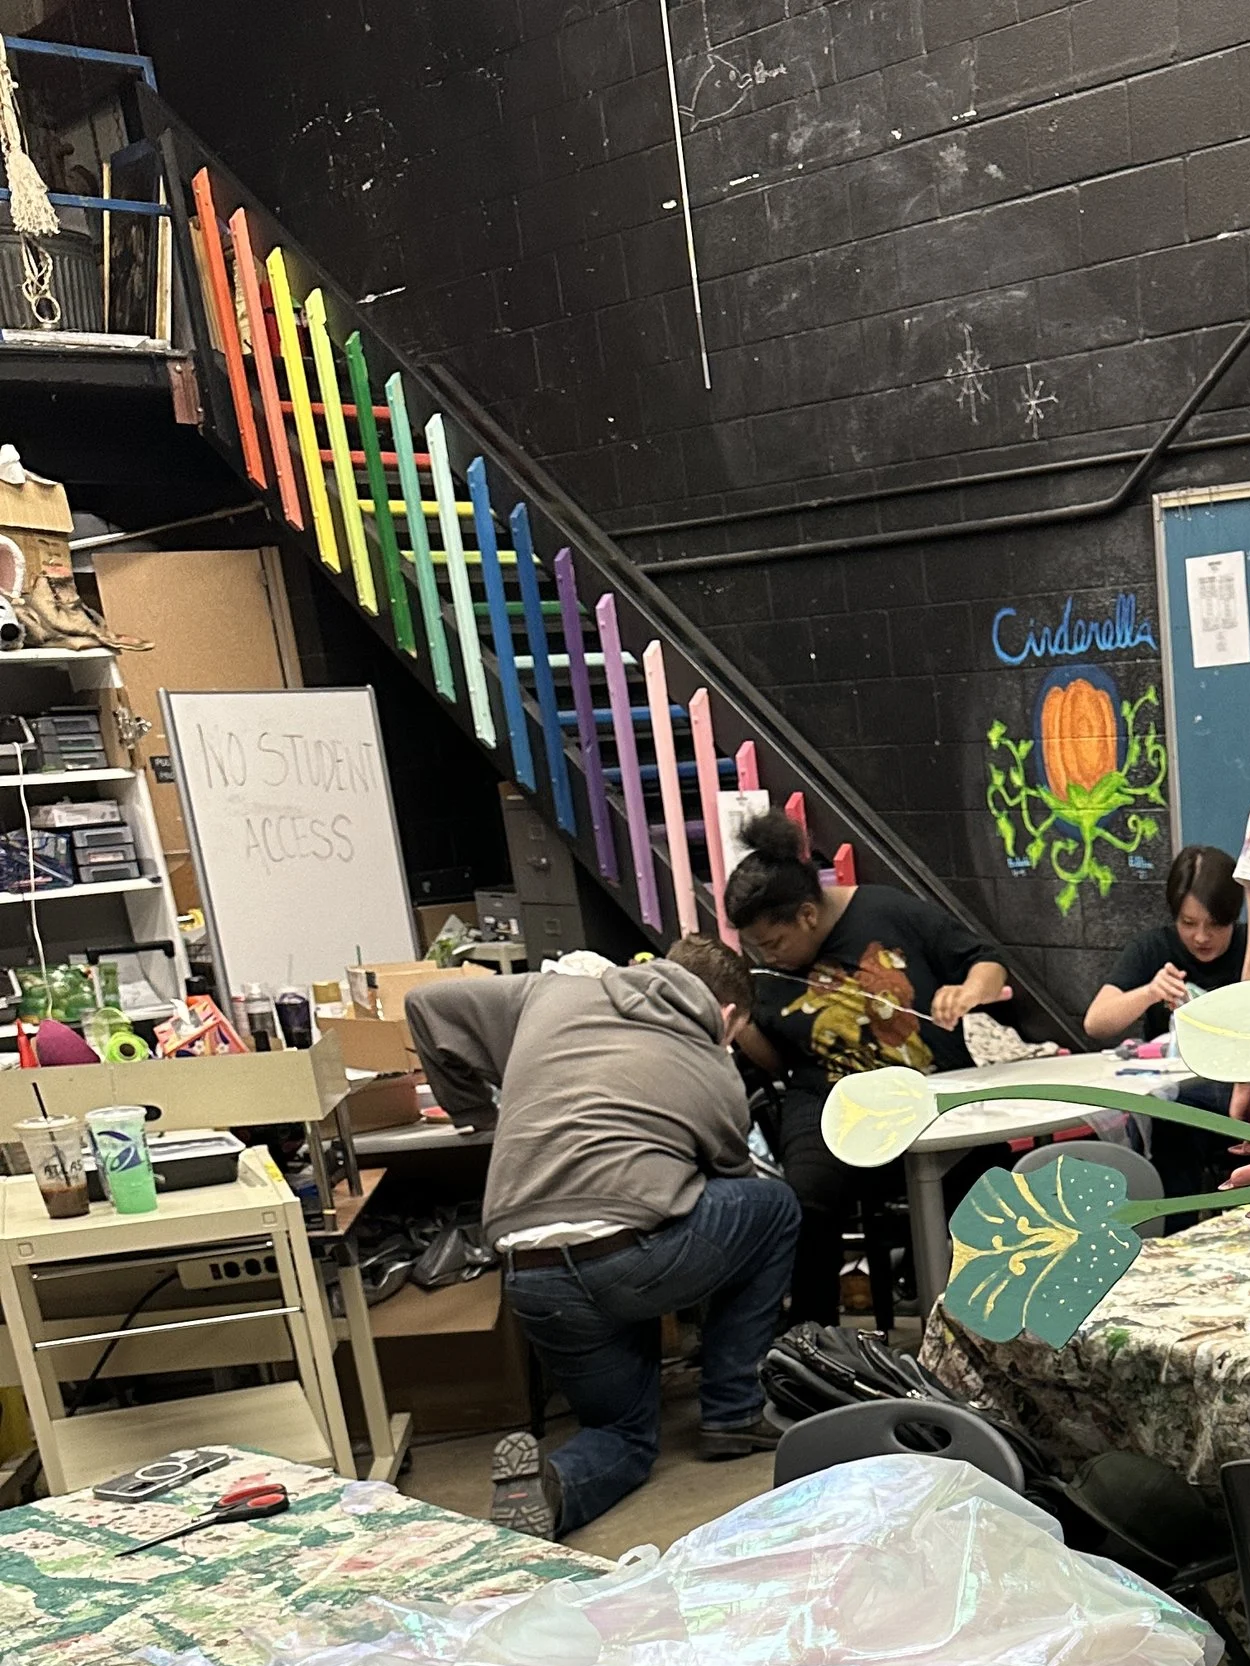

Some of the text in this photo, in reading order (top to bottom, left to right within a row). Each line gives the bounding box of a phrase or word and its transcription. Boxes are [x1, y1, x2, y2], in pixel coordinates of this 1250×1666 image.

[993, 596, 1158, 665] Cinderella
[197, 723, 378, 793] NO STUDENT
[244, 814, 355, 876] ACCESS
